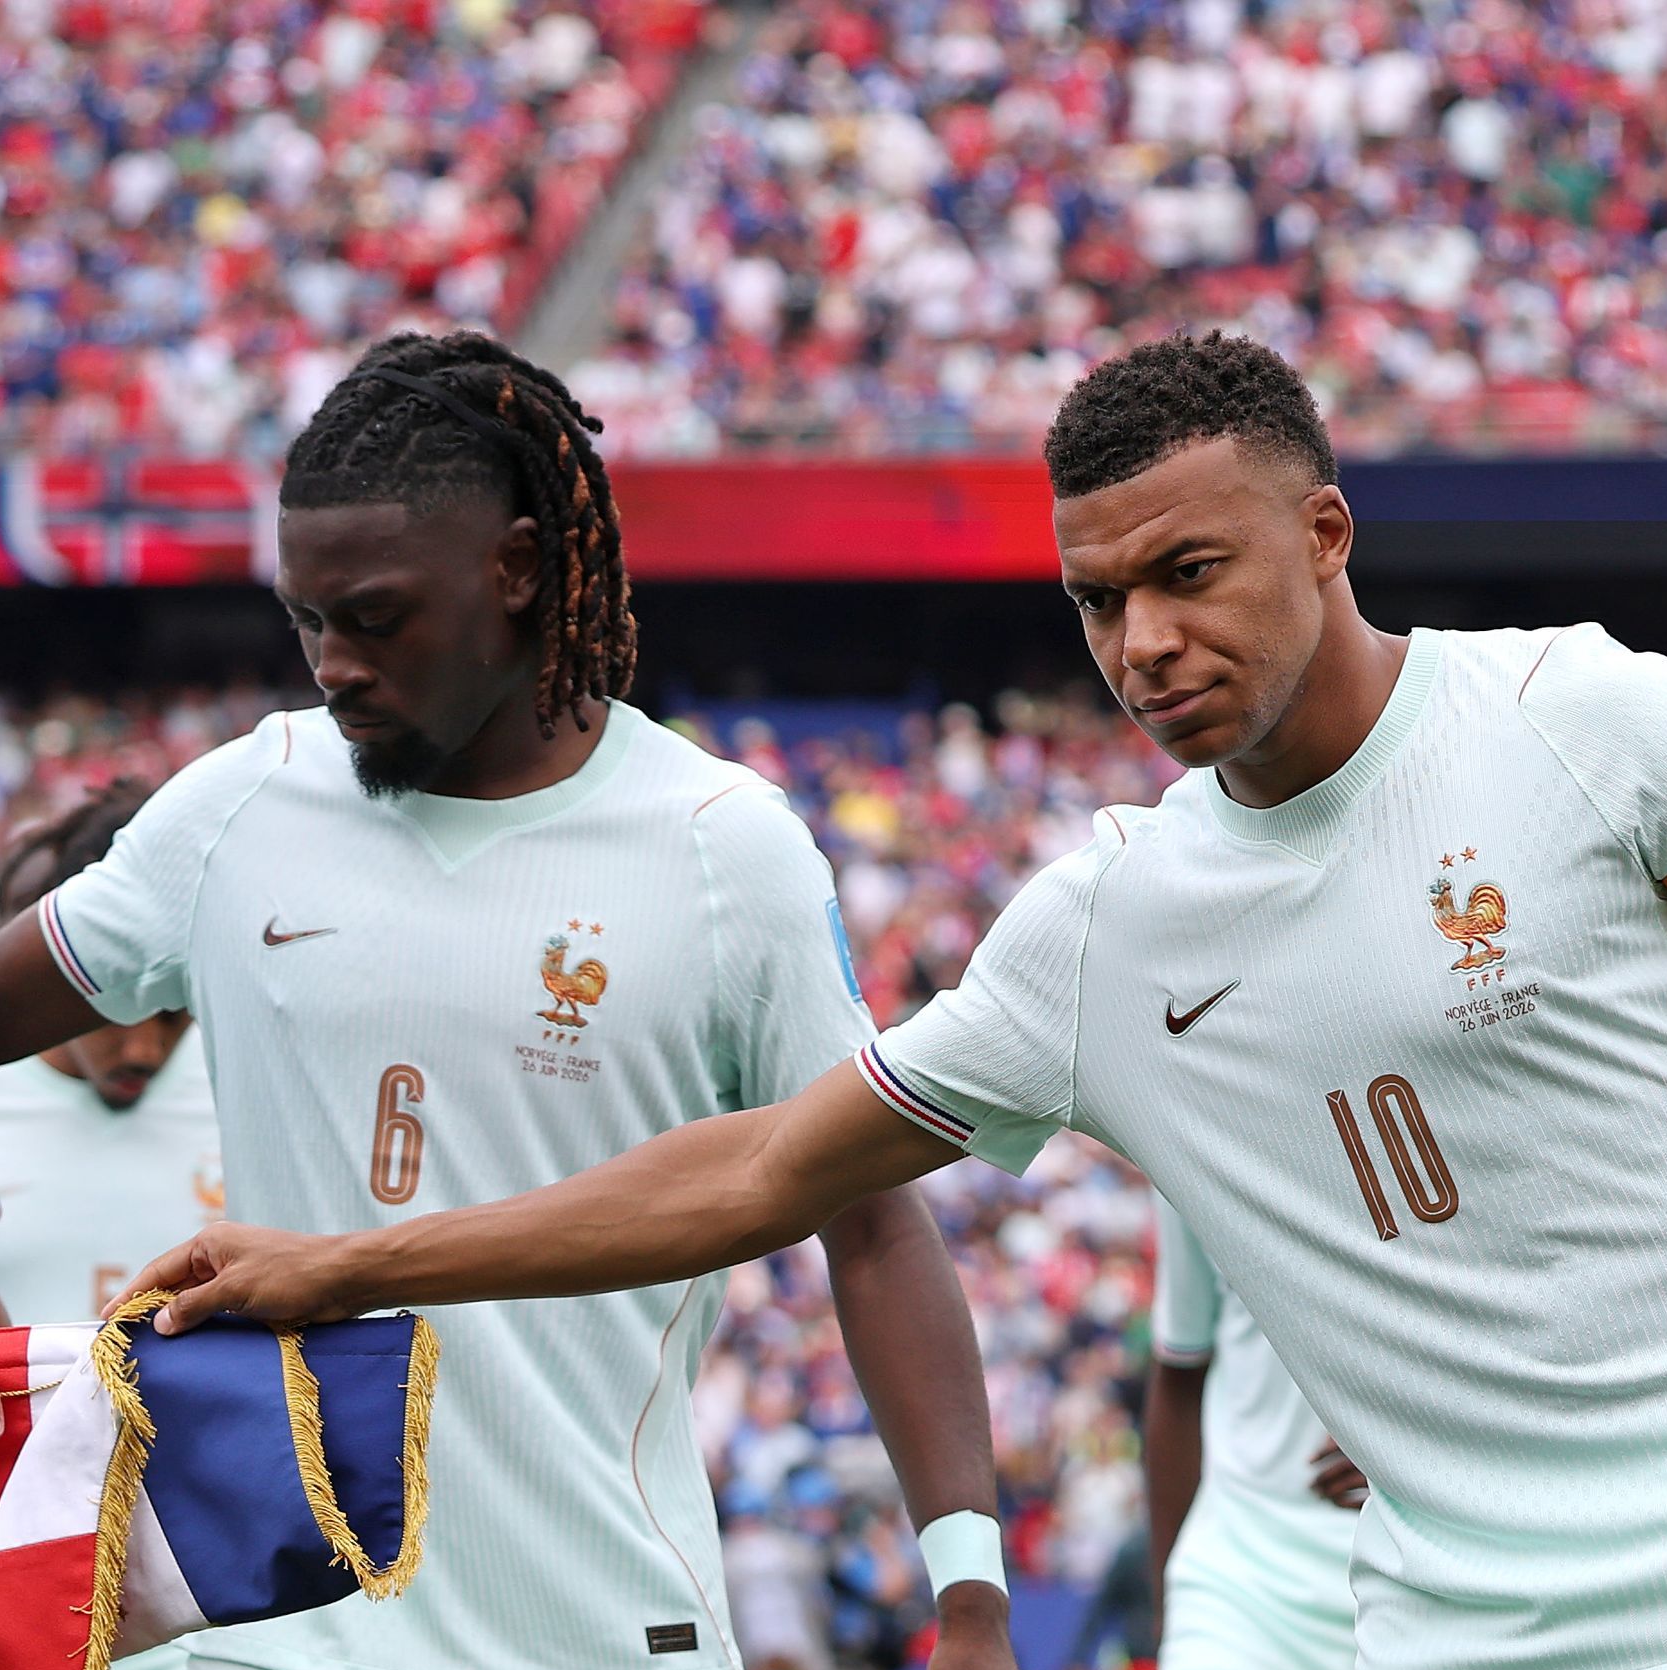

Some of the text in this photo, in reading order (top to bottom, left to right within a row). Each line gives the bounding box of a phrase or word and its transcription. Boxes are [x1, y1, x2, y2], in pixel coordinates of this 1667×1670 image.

[1444, 998, 1492, 1021] NORVÈGE
[1501, 983, 1541, 1006] FRANCE
[1459, 1000, 1536, 1033] 26 JUIN 2026
[522, 1059, 537, 1072] 26
[561, 1067, 589, 1082] 2026
[566, 1055, 600, 1072] FRANCE
[370, 1063, 425, 1204] 6
[1325, 1074, 1459, 1241] 10
